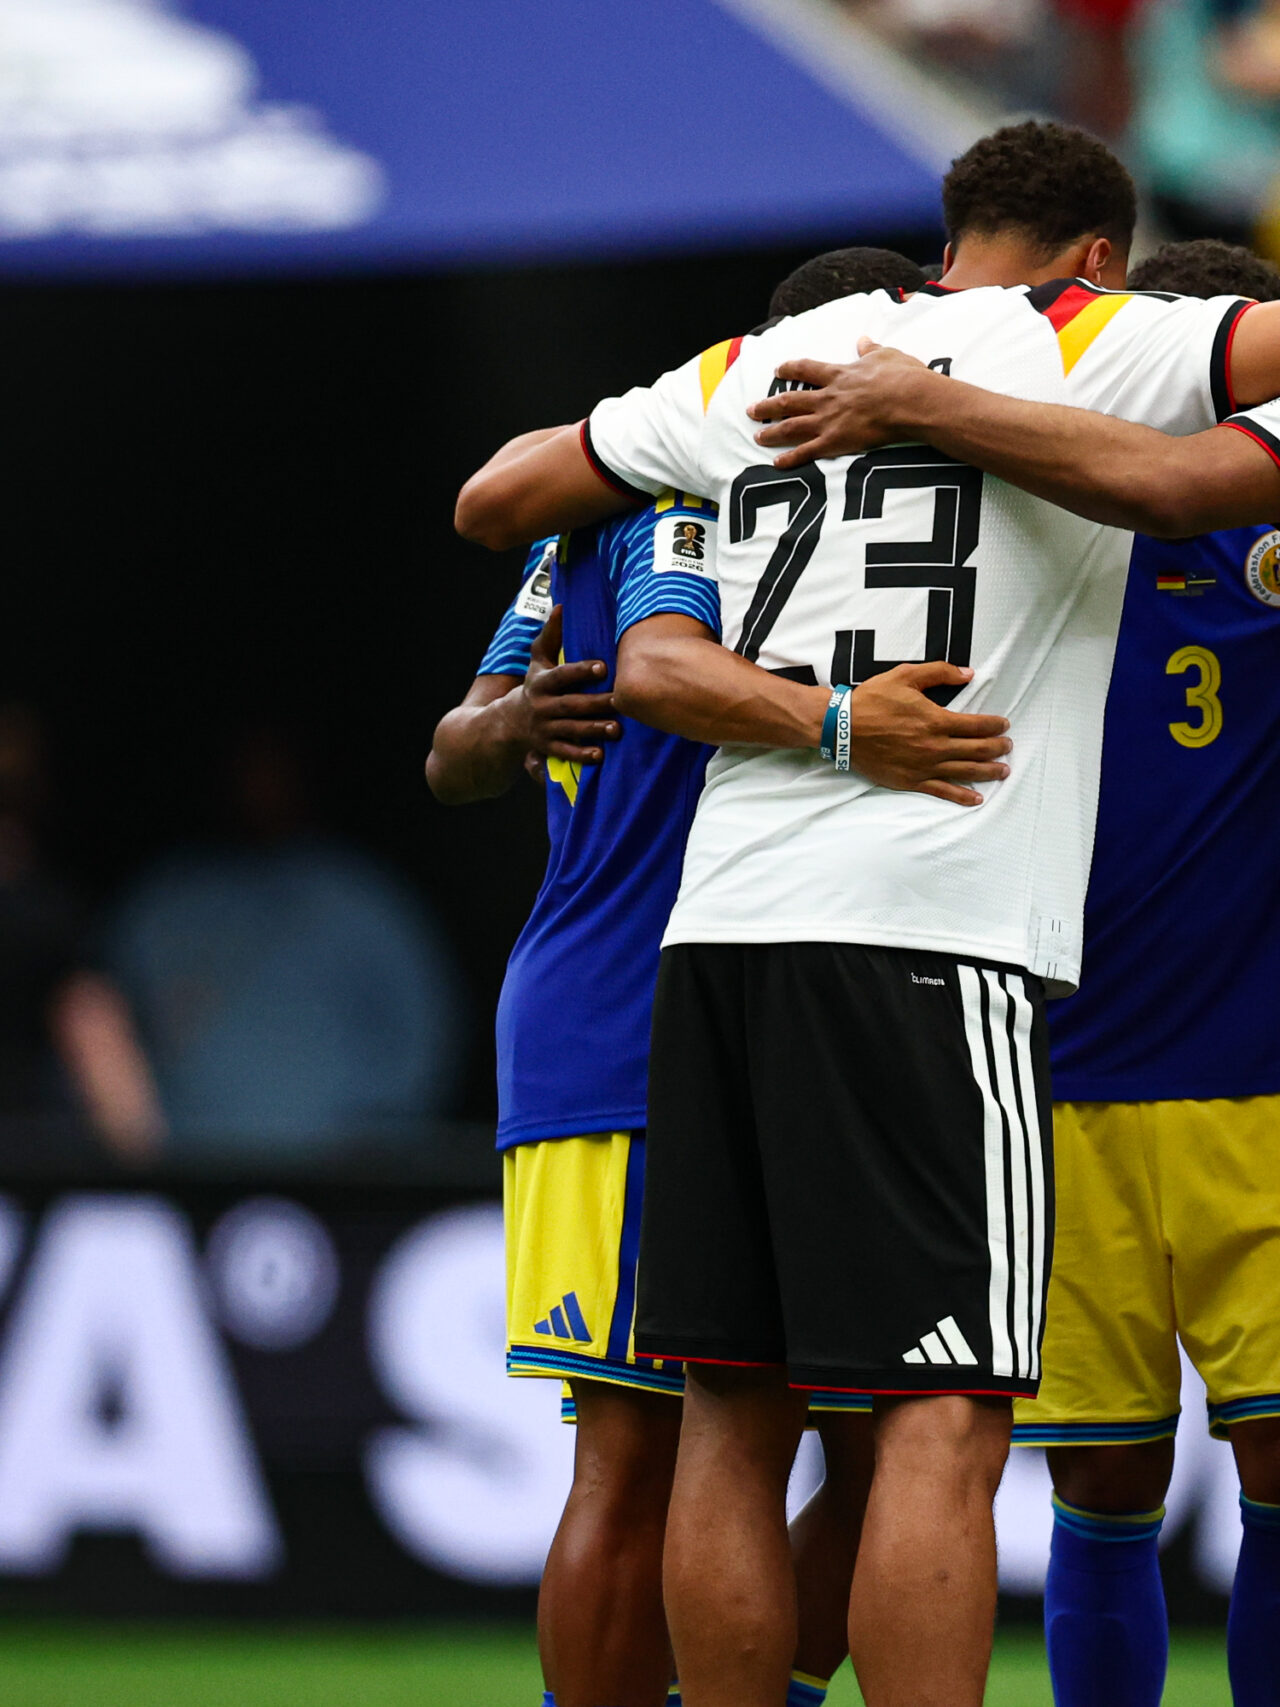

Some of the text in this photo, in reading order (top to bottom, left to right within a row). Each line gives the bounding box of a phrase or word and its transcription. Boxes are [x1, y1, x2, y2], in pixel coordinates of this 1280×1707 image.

[671, 560, 704, 572] 2026
[729, 443, 983, 710] 23
[1251, 541, 1272, 601] Federashon
[1166, 645, 1223, 748] 3
[838, 710, 849, 740] GOD
[838, 744, 849, 757] IN
